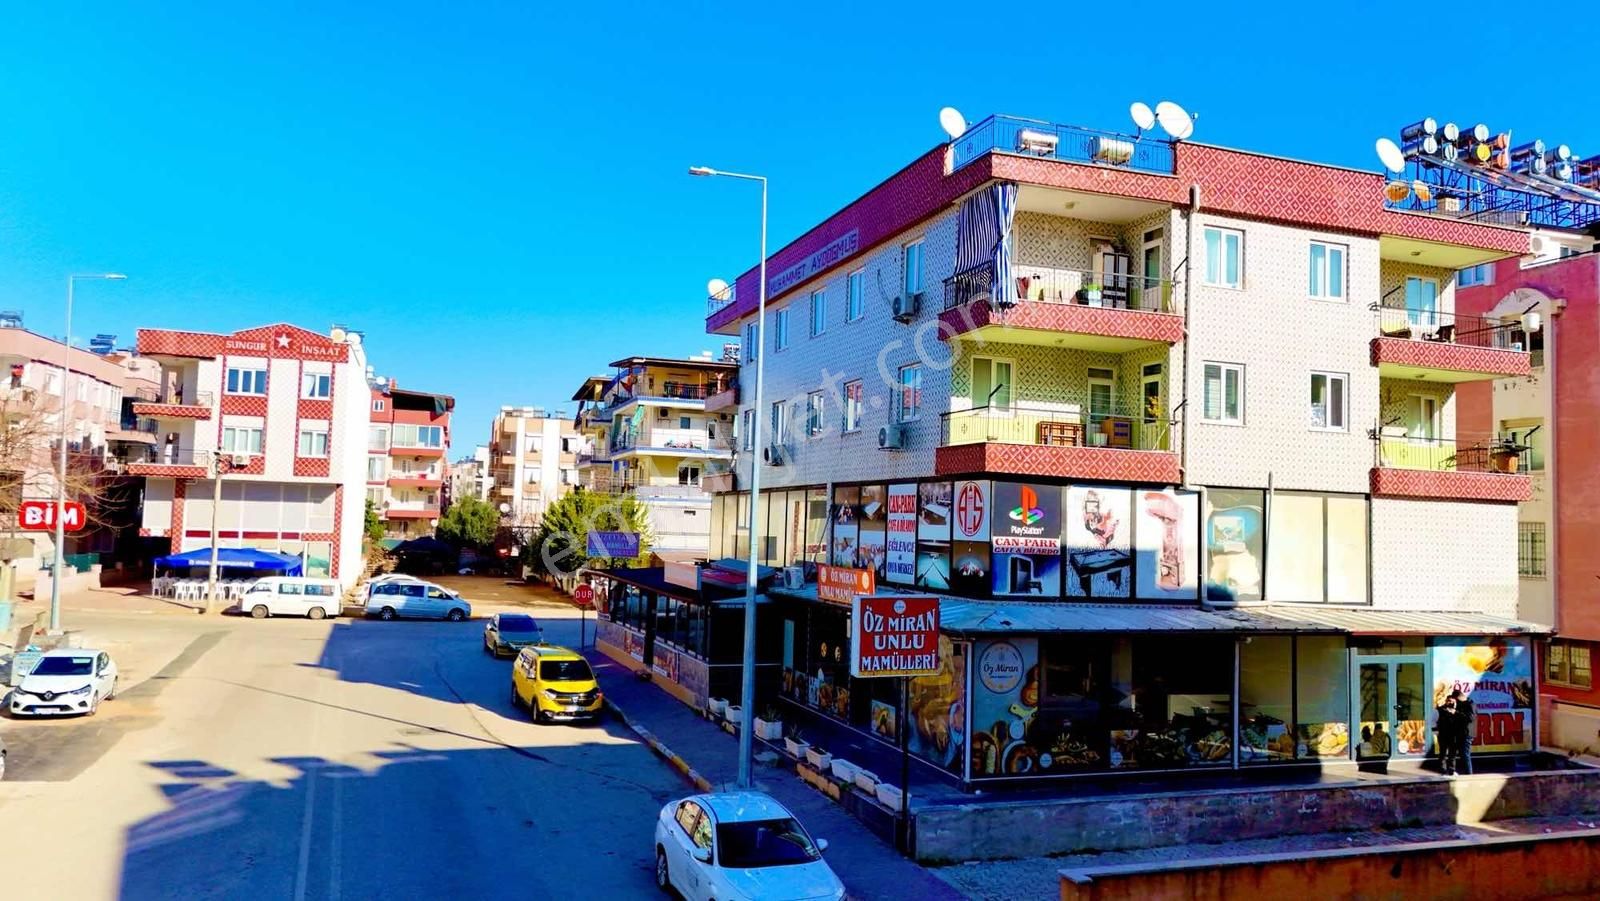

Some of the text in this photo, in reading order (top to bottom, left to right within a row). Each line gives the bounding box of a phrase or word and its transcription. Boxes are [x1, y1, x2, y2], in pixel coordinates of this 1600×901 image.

[225, 340, 267, 351] SUNGUR
[888, 494, 916, 514] CAN-PARK
[25, 503, 78, 525] BİM
[1010, 525, 1042, 536] PlayStation
[995, 538, 1057, 548] CAN-PARK
[575, 590, 592, 599] DUR
[863, 605, 935, 632] ÖZ MİRAN
[874, 634, 925, 650] UNLU
[861, 650, 936, 671] MAMÜLLERİ
[994, 663, 1019, 673] Miran
